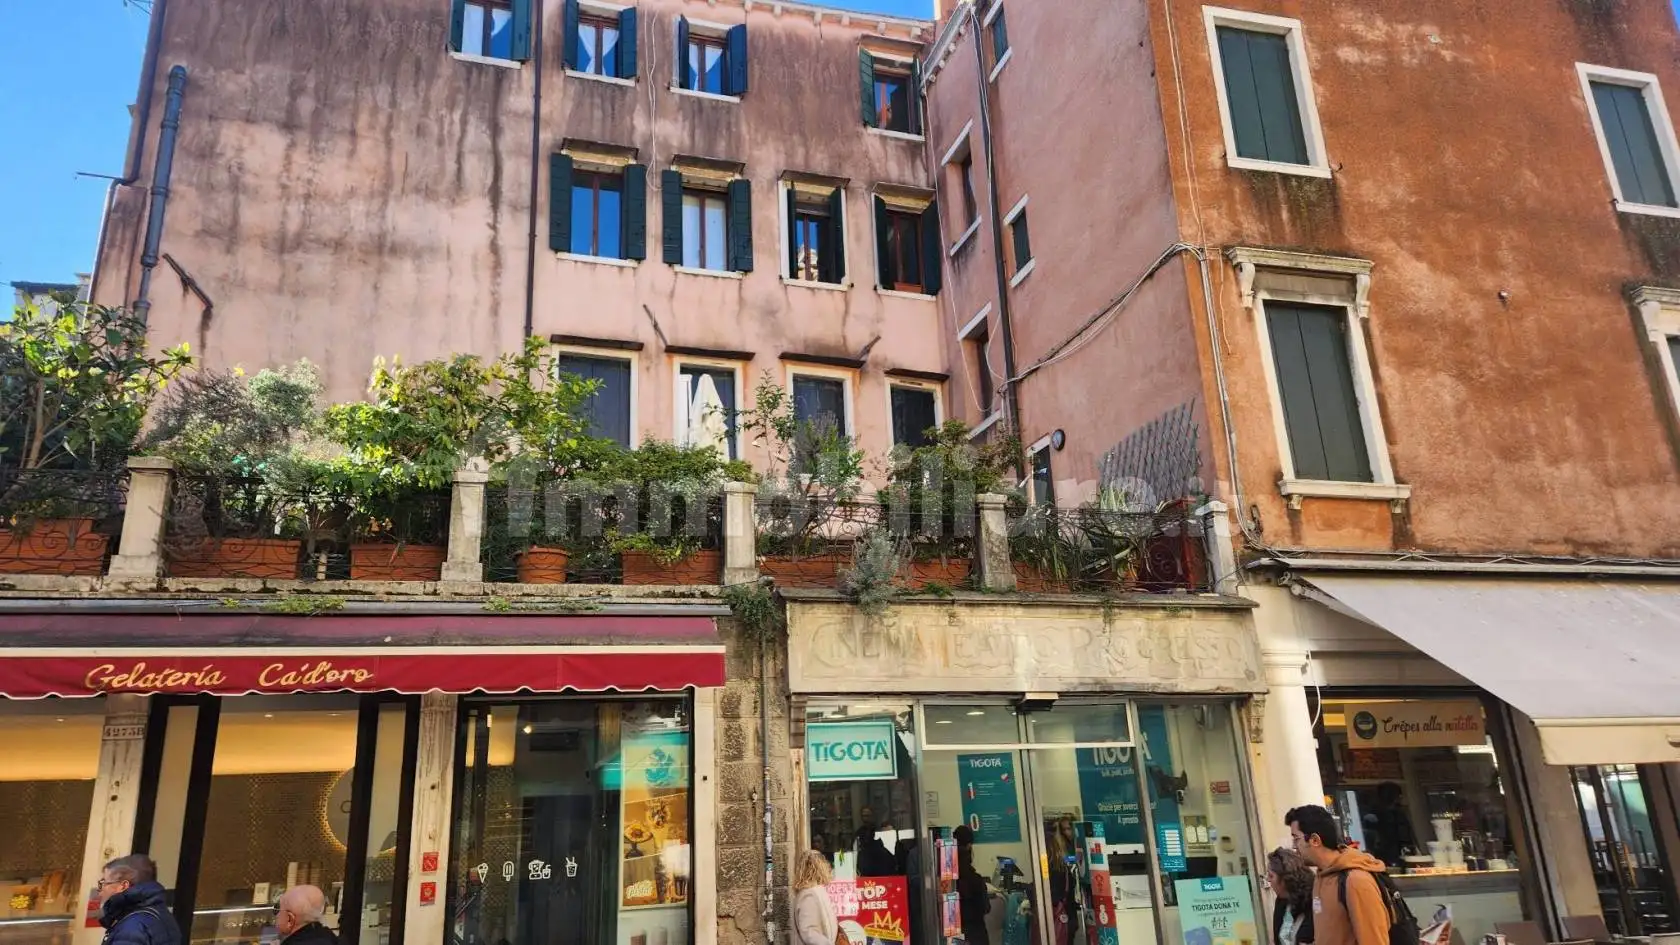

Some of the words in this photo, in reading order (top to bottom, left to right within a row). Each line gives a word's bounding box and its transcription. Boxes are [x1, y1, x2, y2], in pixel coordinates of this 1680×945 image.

[85, 663, 227, 690] Gelateria
[1422, 714, 1442, 732] alla
[862, 901, 889, 910] MESE
